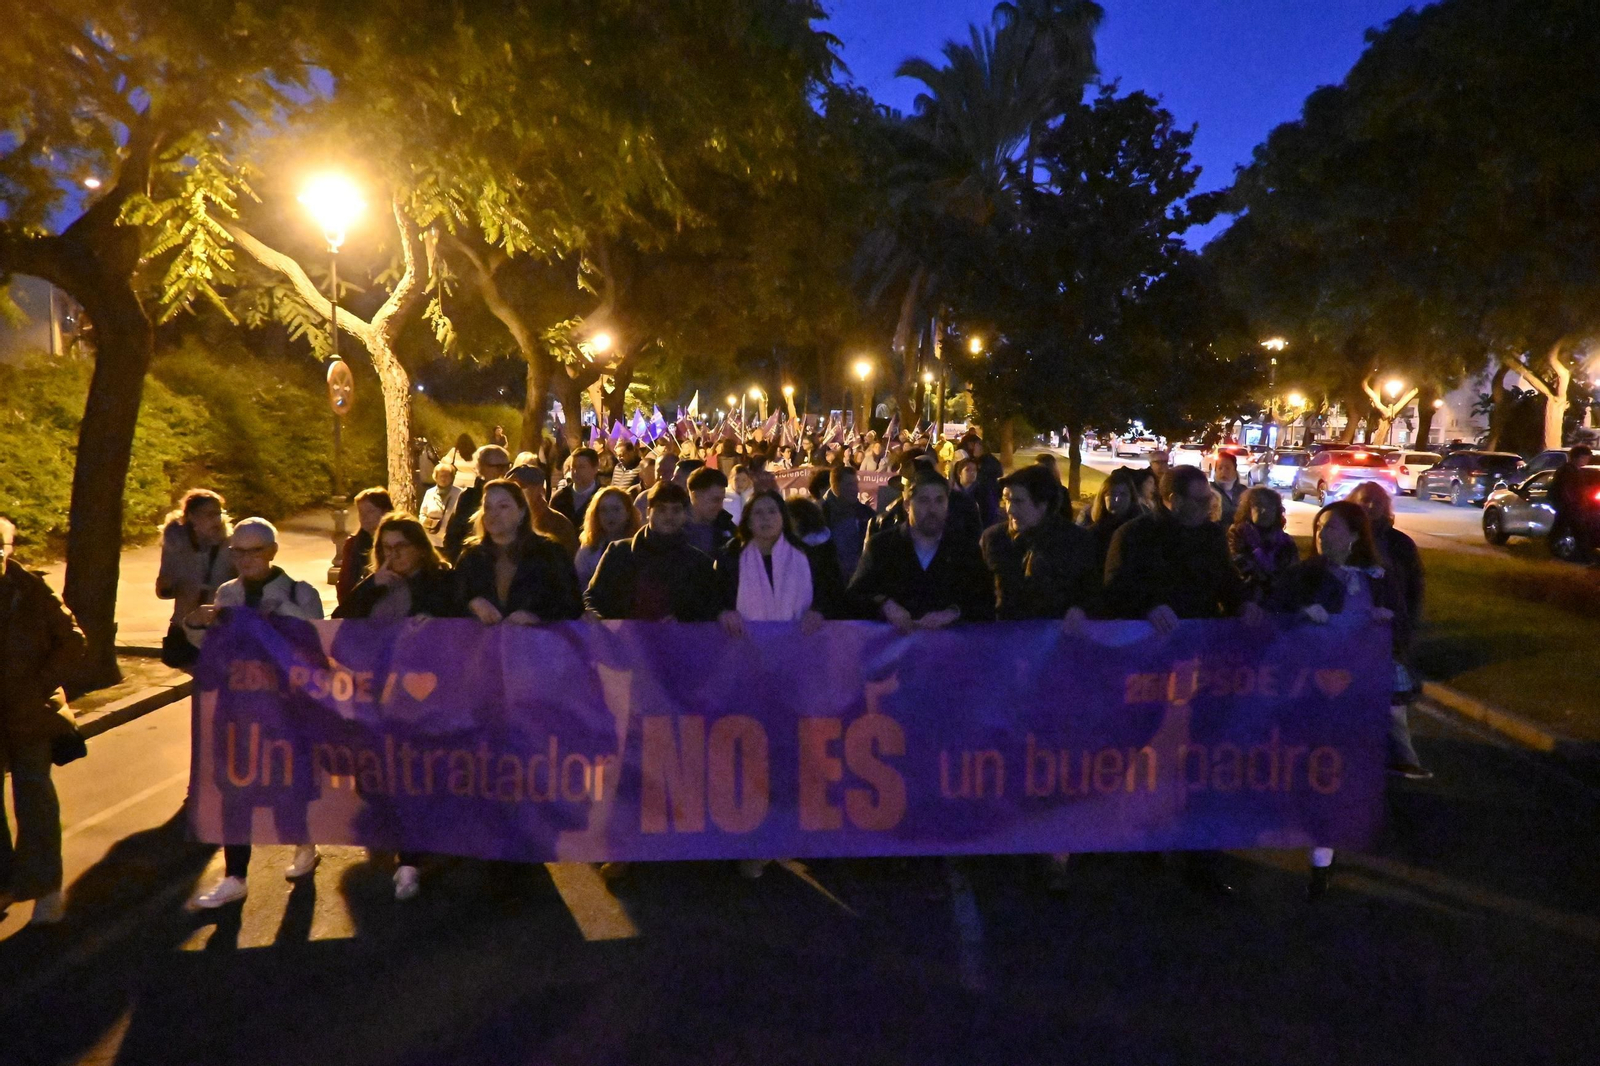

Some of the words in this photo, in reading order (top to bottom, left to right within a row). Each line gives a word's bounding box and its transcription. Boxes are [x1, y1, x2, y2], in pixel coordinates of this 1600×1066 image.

[863, 474, 890, 484] mujer
[227, 721, 295, 788] Un
[312, 733, 617, 805] maltratador
[640, 712, 772, 834] NO
[797, 711, 907, 832] ES
[938, 748, 1007, 799] un
[1024, 731, 1158, 799] buen
[1178, 727, 1344, 807] padre
